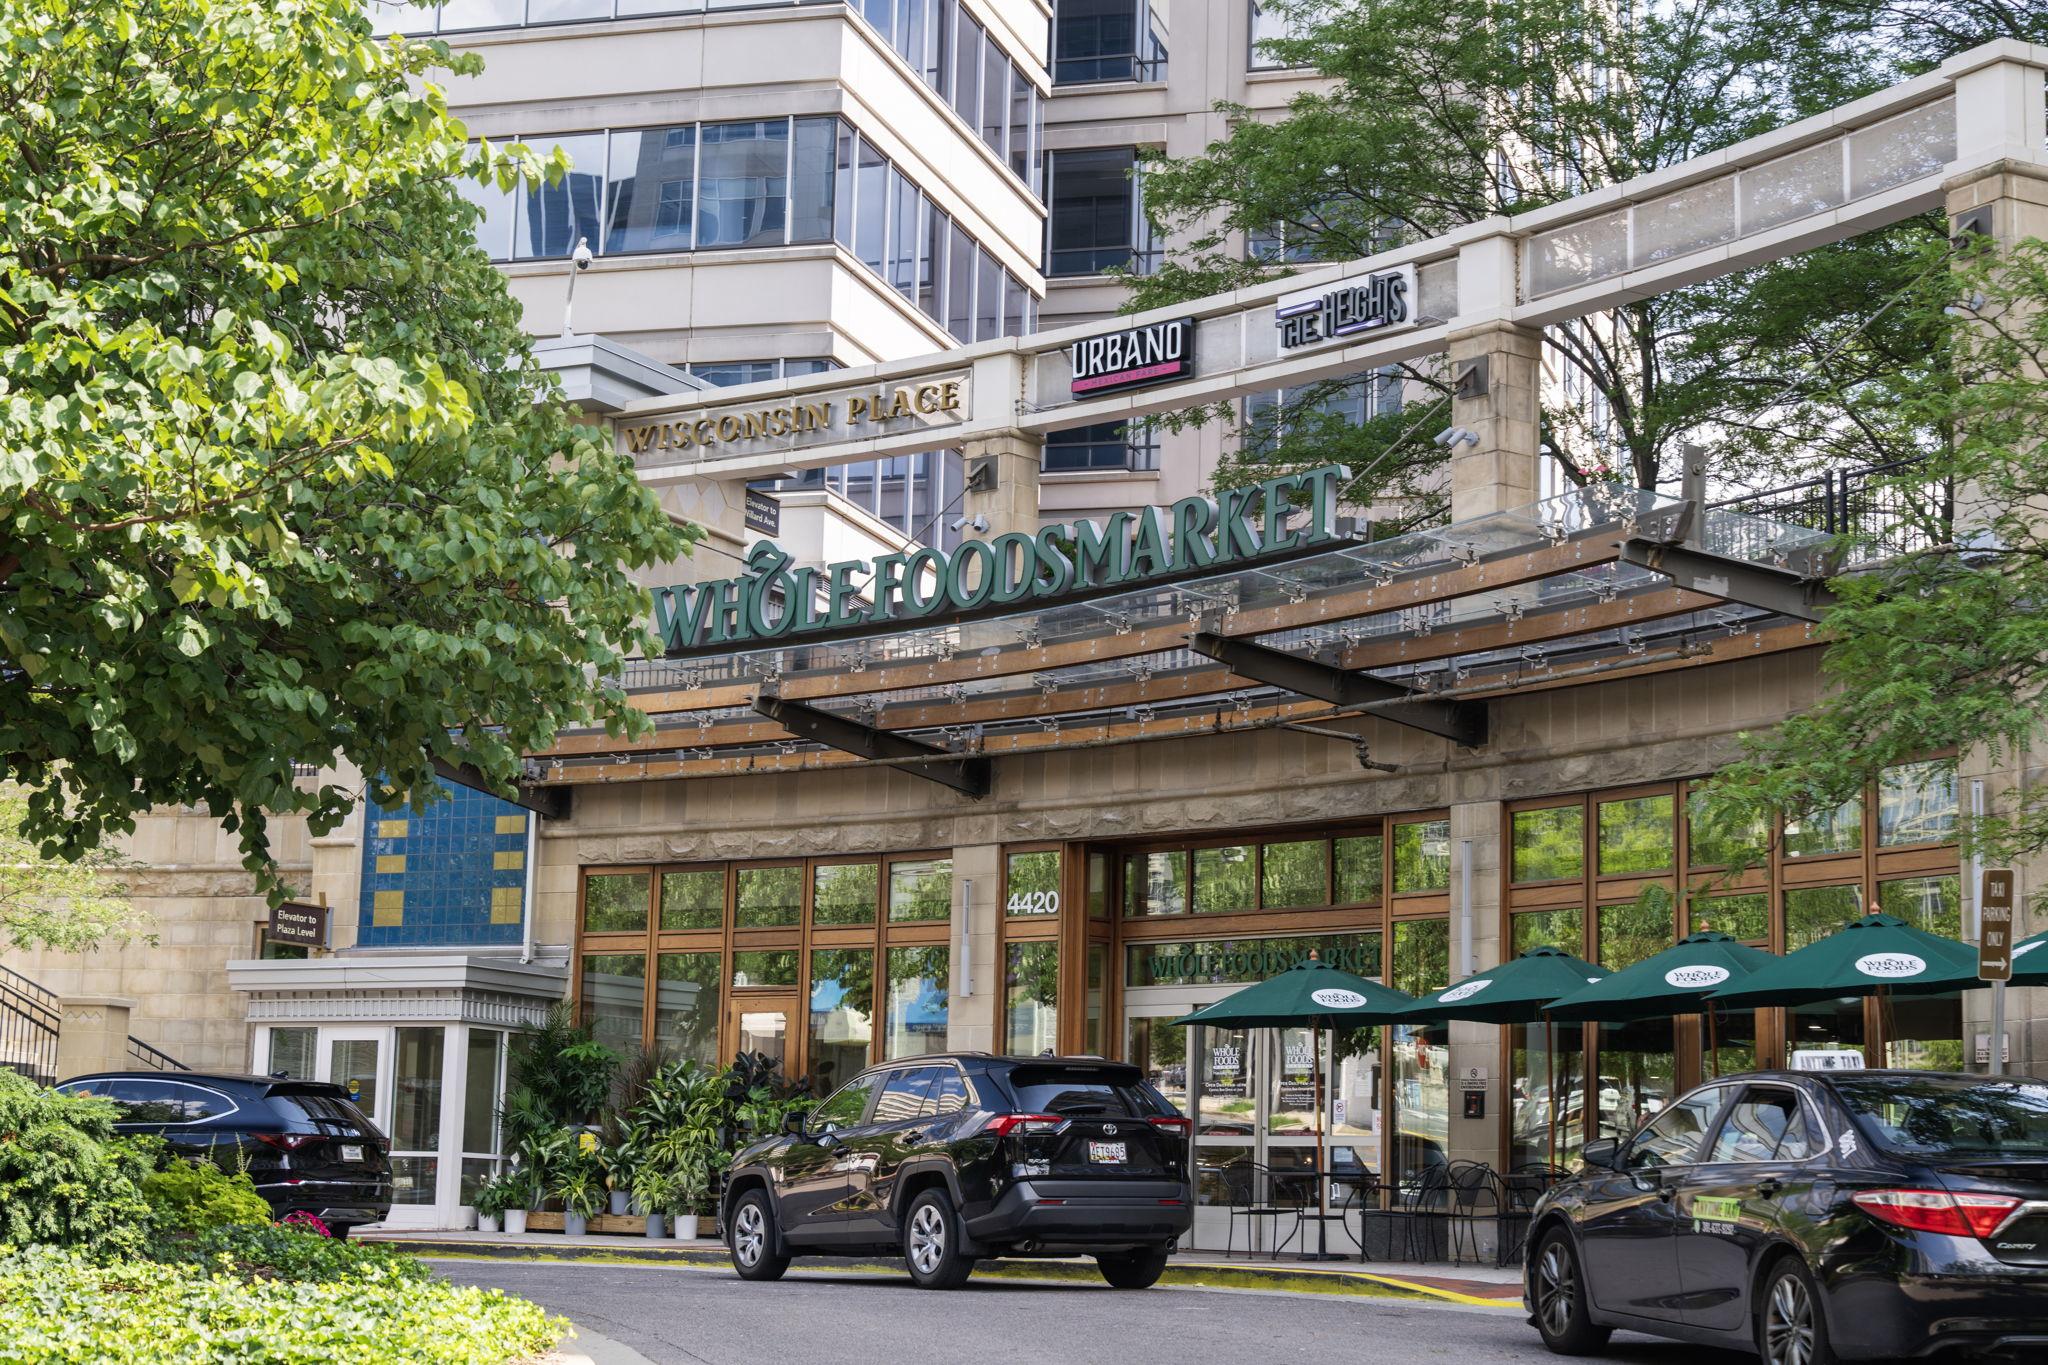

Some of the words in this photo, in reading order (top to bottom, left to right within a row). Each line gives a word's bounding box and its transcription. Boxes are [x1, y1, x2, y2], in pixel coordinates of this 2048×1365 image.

[1277, 313, 1319, 349] THE
[1321, 271, 1407, 337] HEIGHTS
[1072, 321, 1182, 380] URBANO
[1091, 370, 1132, 387] MEXICAN
[1134, 366, 1161, 380] FARE
[623, 402, 832, 453] WISCONSIN
[846, 381, 961, 425] PLACE
[747, 497, 769, 512] Elevator
[770, 507, 777, 515] to
[652, 540, 870, 651] WHOLE
[868, 523, 1073, 624] FOODS
[1071, 465, 1352, 590] MARKET
[1990, 882, 2005, 898] TAXI
[1007, 890, 1058, 914] 4420
[278, 910, 307, 923] Elevator
[308, 915, 317, 924] to
[1983, 907, 2011, 922] PARKING
[277, 923, 296, 935] Plaza
[297, 926, 316, 938] Level
[1987, 931, 2005, 947] ONLY
[1149, 944, 1215, 978] WHOLE
[1217, 949, 1290, 974] FOODS
[1863, 959, 1916, 967] WHOLE
[1213, 1044, 1240, 1057] WHOLE
[1285, 1042, 1313, 1055] WHOLE
[1214, 1056, 1239, 1066] FOODS
[1286, 1055, 1314, 1065] FOODS
[1840, 1055, 1860, 1069] TAXI
